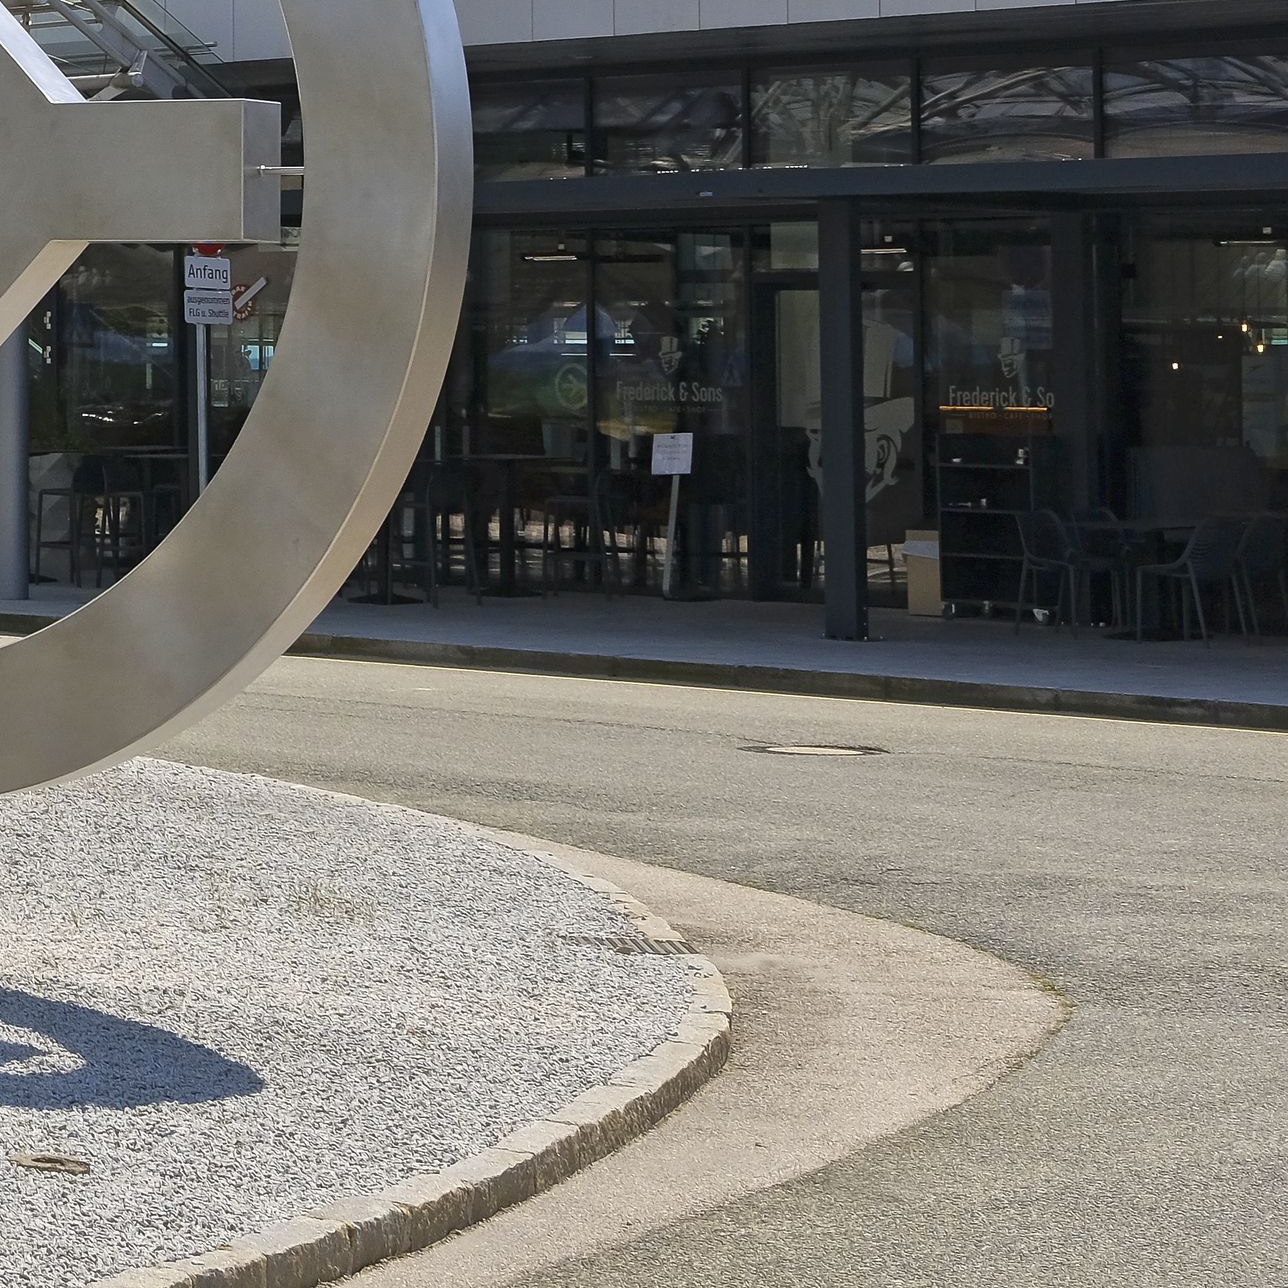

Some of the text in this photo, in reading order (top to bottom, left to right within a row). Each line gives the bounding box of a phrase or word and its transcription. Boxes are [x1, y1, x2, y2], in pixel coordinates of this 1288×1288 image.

[188, 264, 228, 284] Anfang
[189, 308, 201, 317] FLG
[616, 381, 723, 402] Frederick & Sons
[949, 385, 1055, 408] Frederick & So
